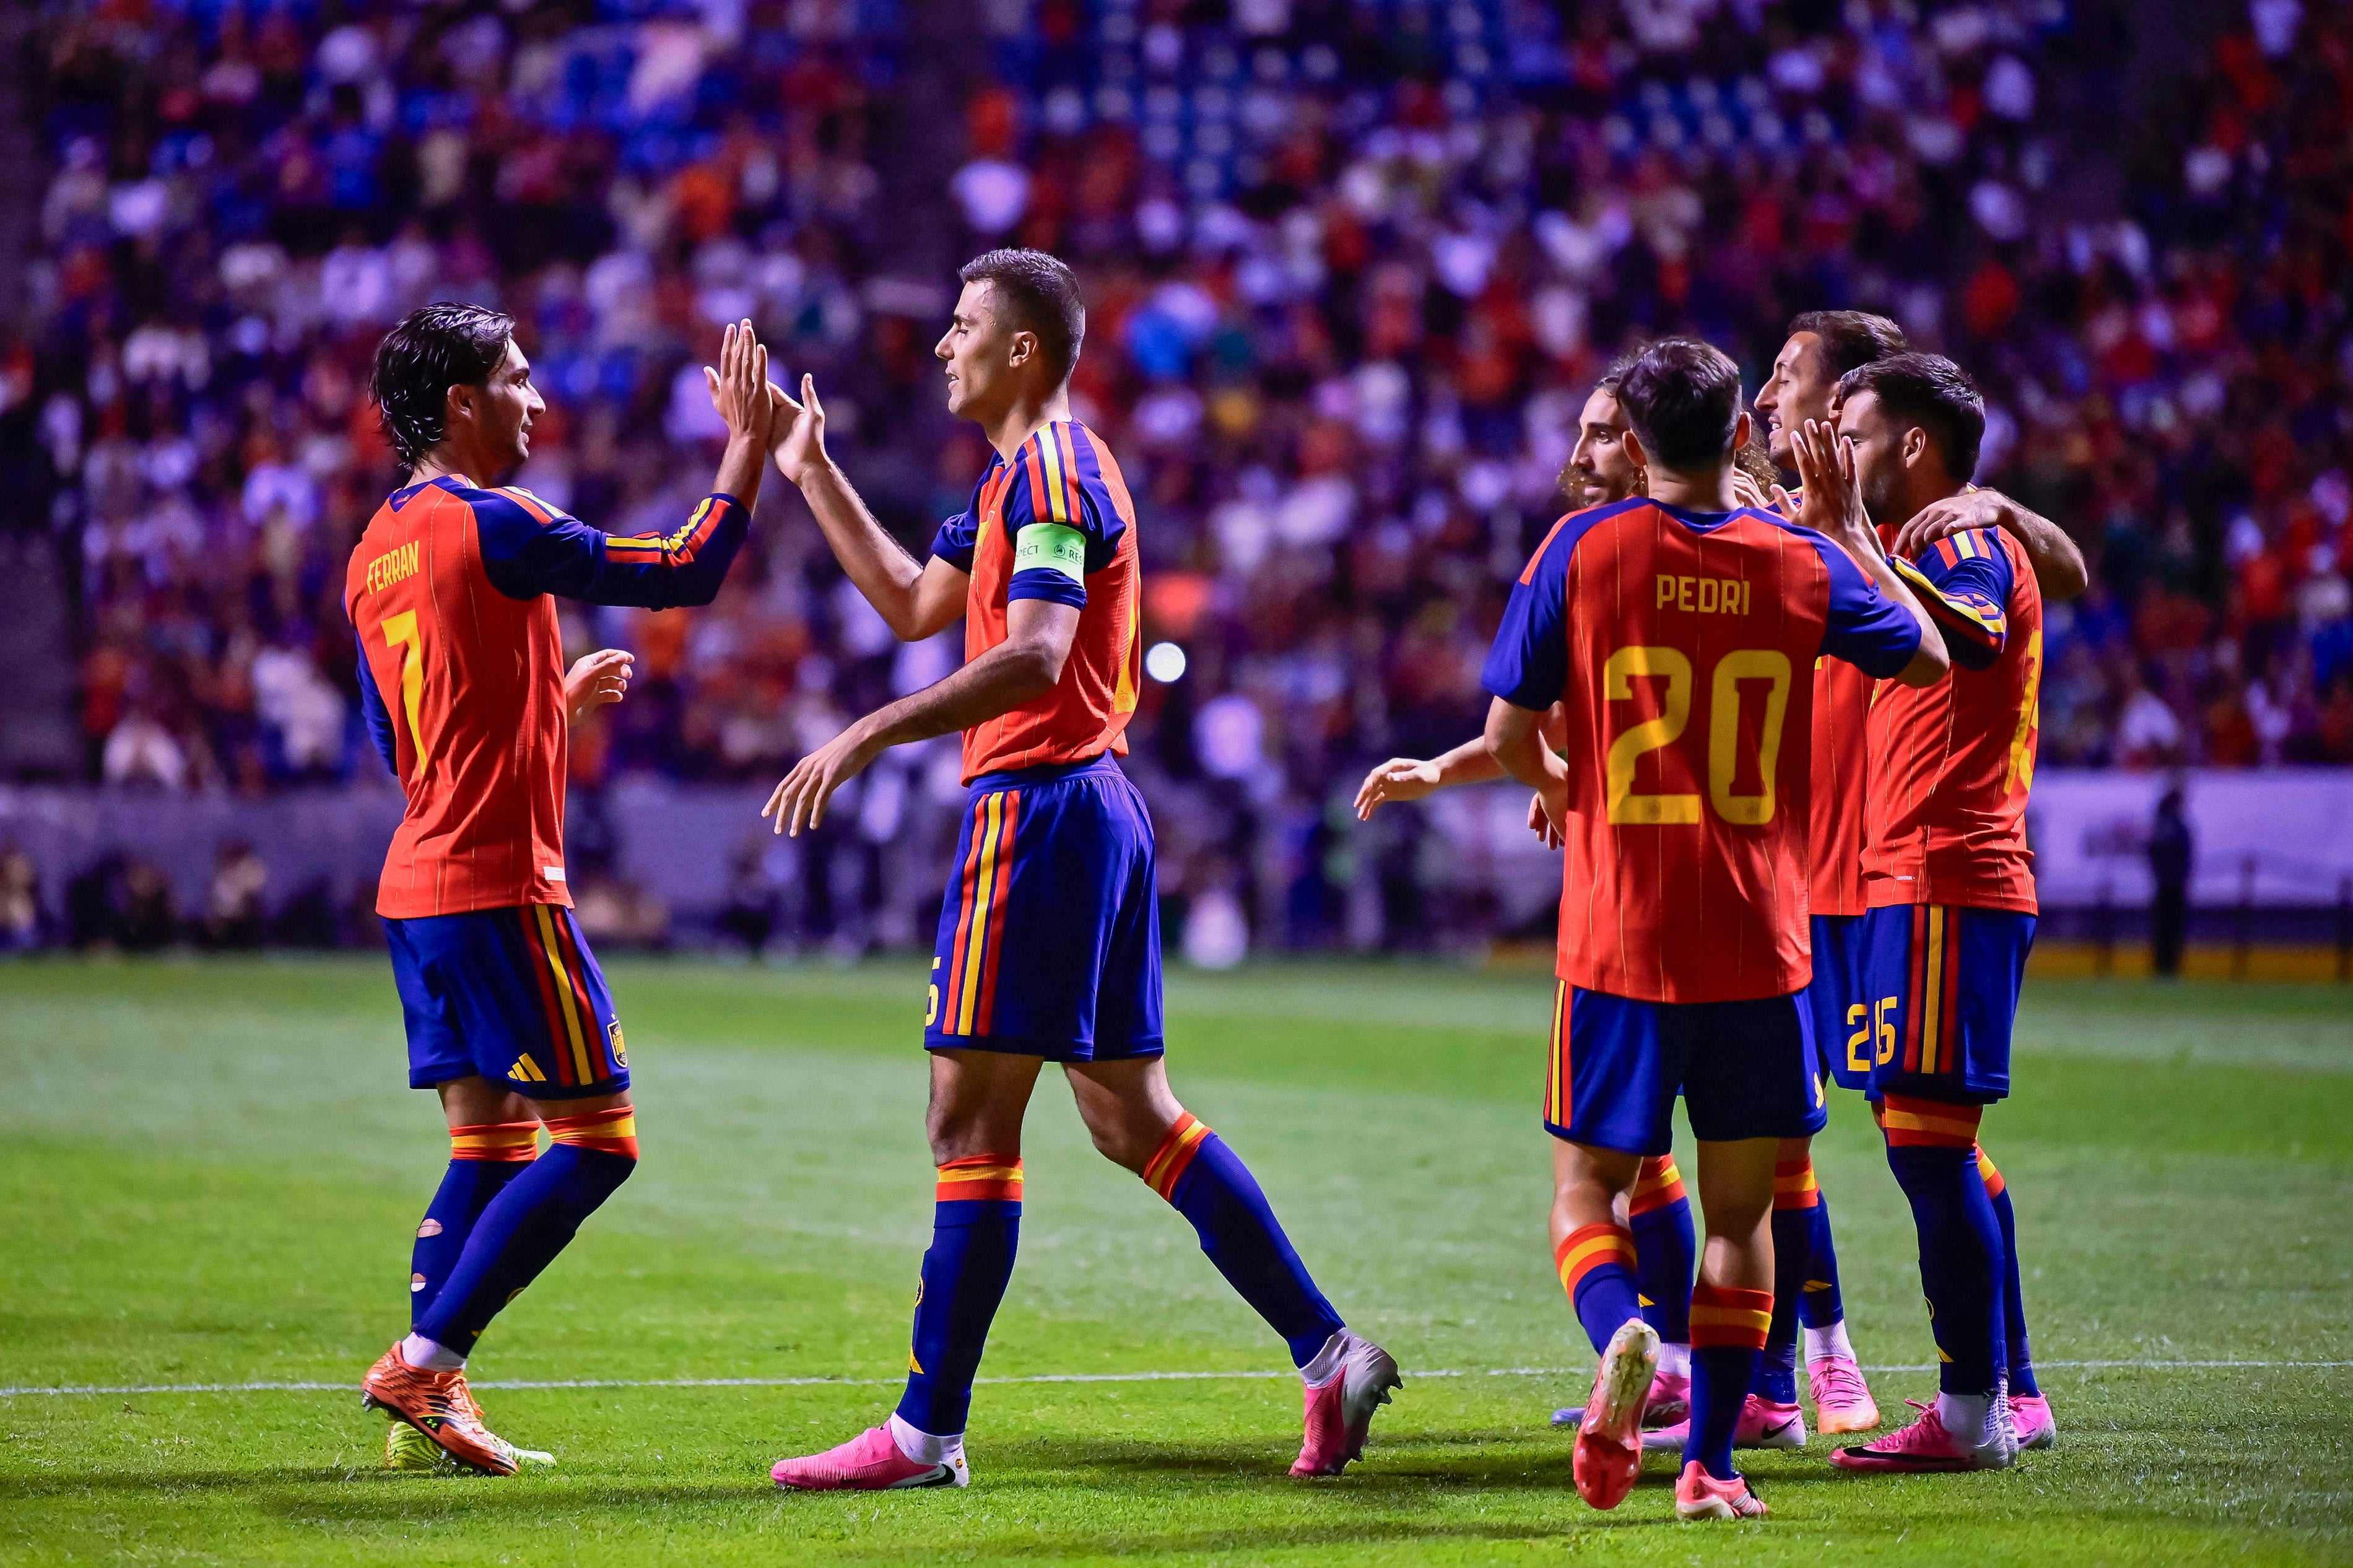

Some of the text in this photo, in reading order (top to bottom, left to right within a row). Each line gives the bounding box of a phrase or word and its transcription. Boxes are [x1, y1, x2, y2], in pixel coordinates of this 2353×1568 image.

[366, 540, 420, 595] FERRAN
[1016, 545, 1039, 557] PECT
[1656, 574, 1751, 616] PEDRI
[380, 609, 428, 775] 7
[1603, 645, 1792, 825] 20
